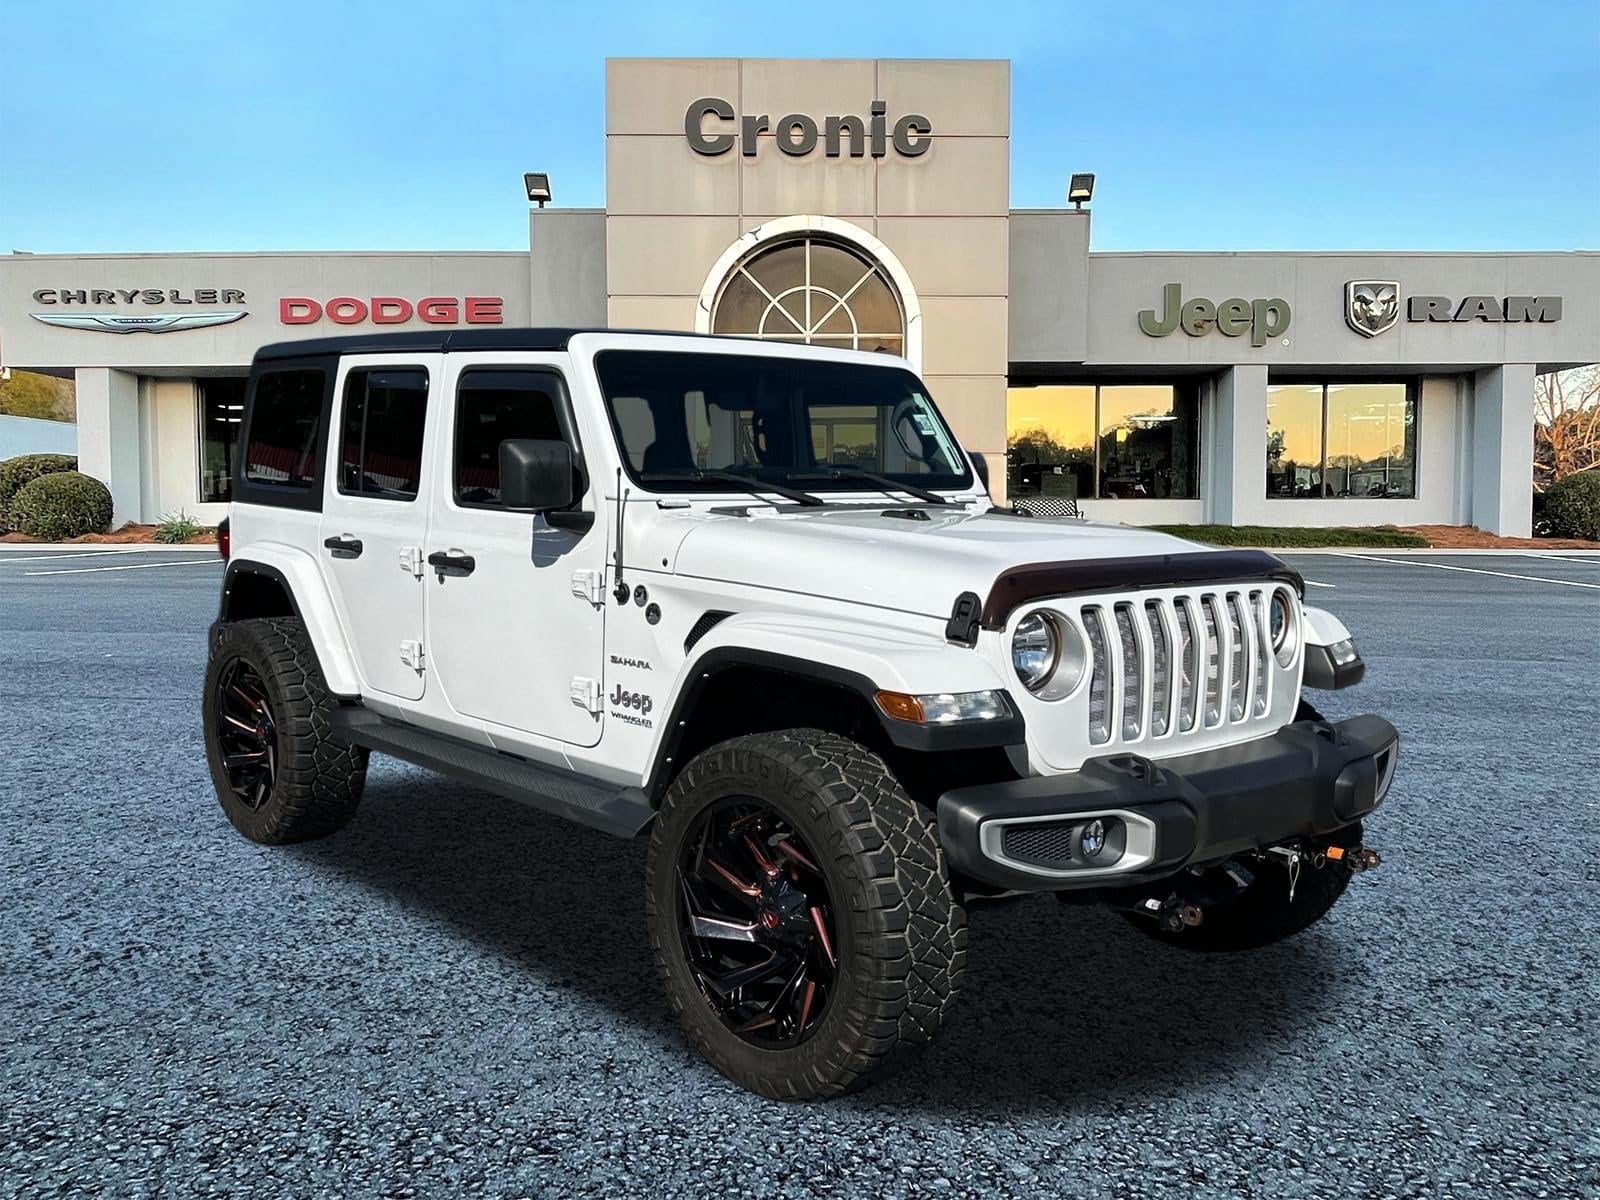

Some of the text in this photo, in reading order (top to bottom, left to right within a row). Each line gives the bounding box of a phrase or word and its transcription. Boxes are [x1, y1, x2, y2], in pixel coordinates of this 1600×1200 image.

[684, 97, 932, 157] Cronic
[32, 289, 247, 305] CHRYSLER
[1407, 296, 1563, 322] RAM
[279, 297, 503, 325] DODGE
[1138, 283, 1291, 347] Jeep
[610, 655, 653, 670] SAHARA
[610, 684, 653, 715] Jeep
[611, 711, 653, 726] WRANGLER
